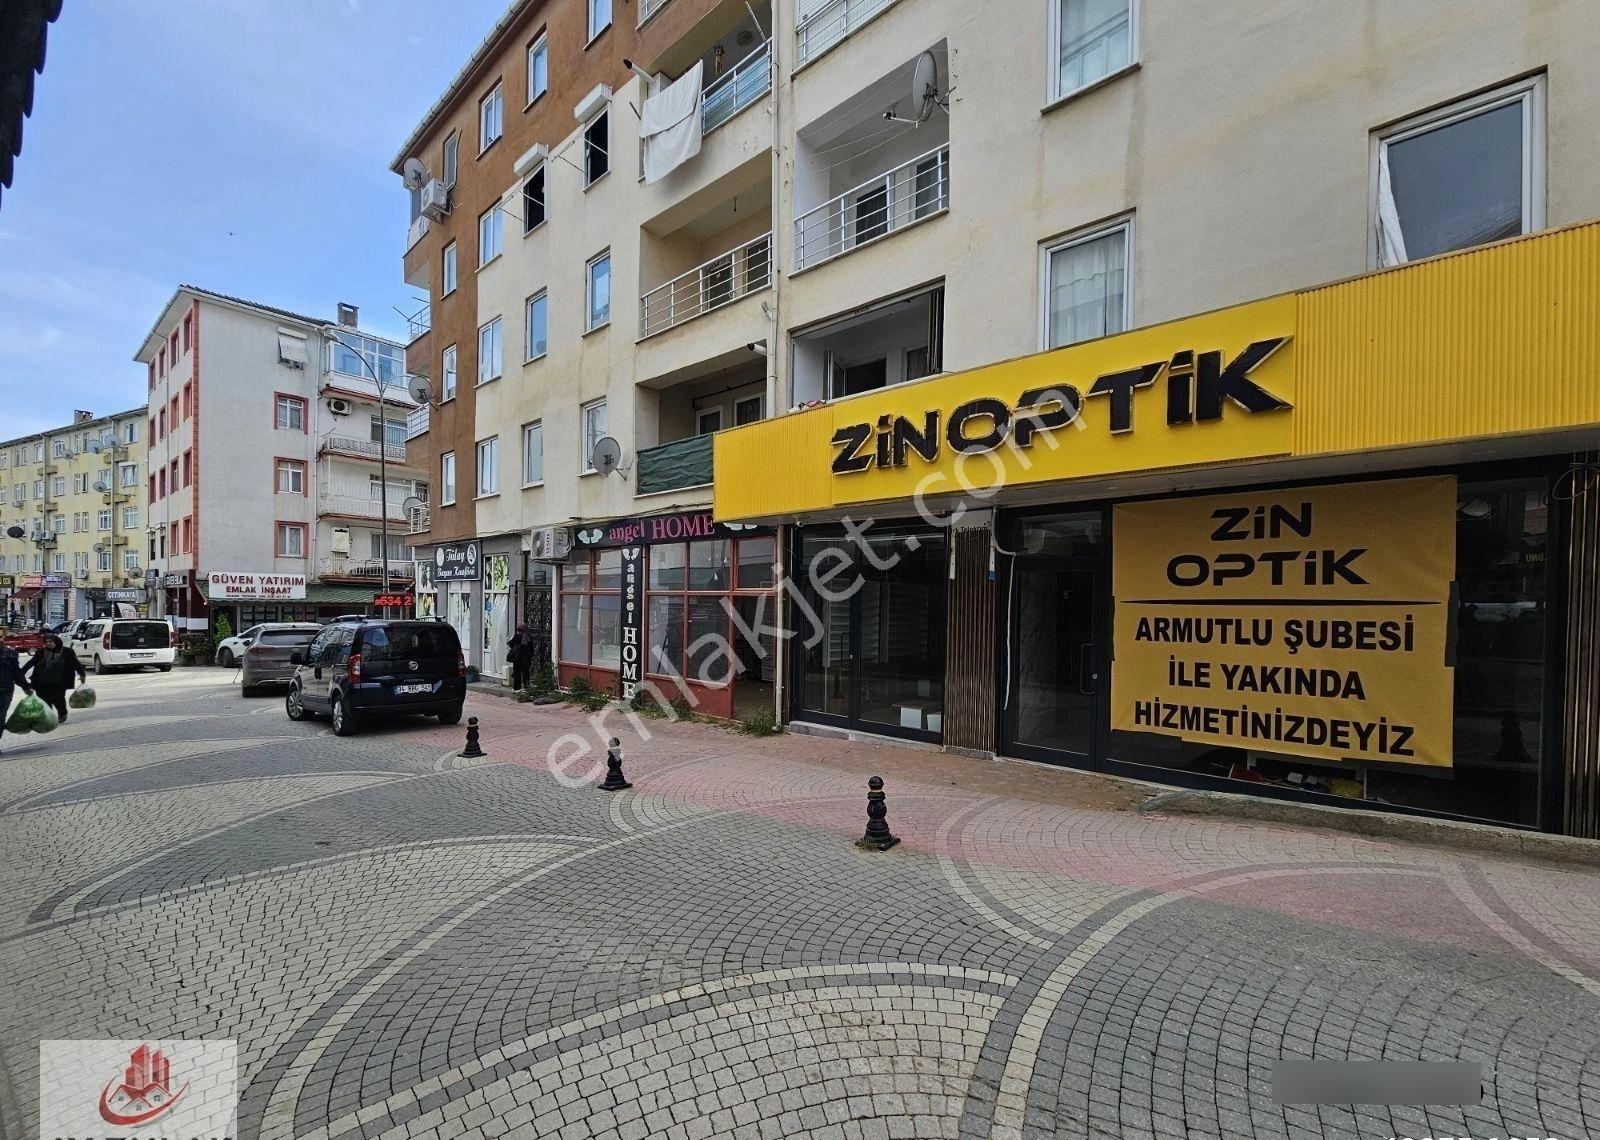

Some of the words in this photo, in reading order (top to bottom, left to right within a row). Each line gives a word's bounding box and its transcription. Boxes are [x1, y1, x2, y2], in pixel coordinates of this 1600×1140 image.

[609, 523, 646, 544] angel
[651, 513, 715, 540] HOME
[211, 573, 254, 584] GÜVEN
[259, 575, 304, 586] YATIRIM
[225, 585, 257, 593] EMLAK
[626, 563, 635, 624] angel
[1134, 616, 1274, 646] ARMUTLU
[1283, 613, 1415, 655] ŞUBESİ
[622, 626, 638, 699] HOME
[1168, 654, 1211, 689] İLE
[1219, 663, 1367, 701] YAKINDA
[1134, 696, 1415, 757] HİZMETİNİZDEYİZ
